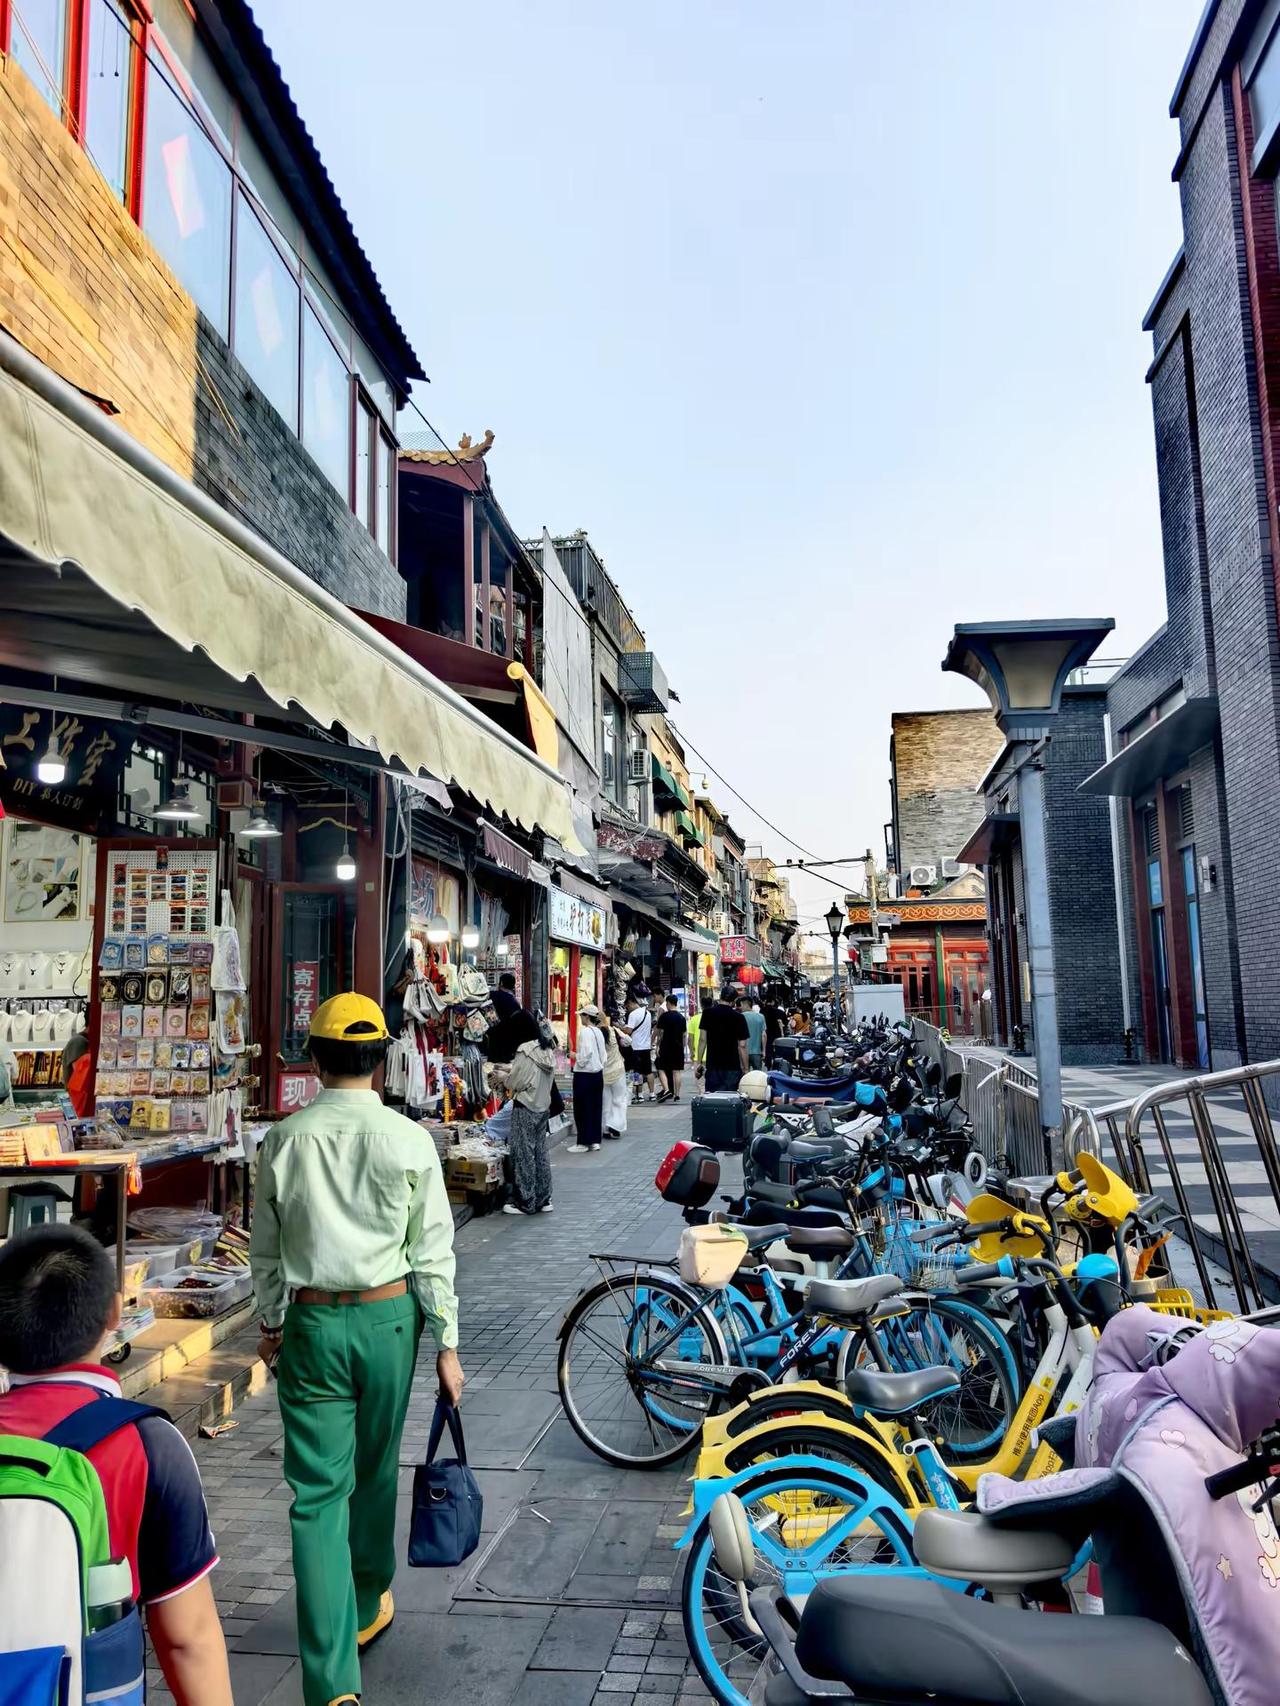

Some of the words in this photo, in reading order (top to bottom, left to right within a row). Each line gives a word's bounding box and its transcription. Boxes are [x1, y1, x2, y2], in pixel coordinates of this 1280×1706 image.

[13, 778, 37, 796] DIY
[293, 968, 314, 1026] 寄存点
[694, 1365, 735, 1374] FOREVER
[1012, 1394, 1044, 1457] 推荐使用美团App
